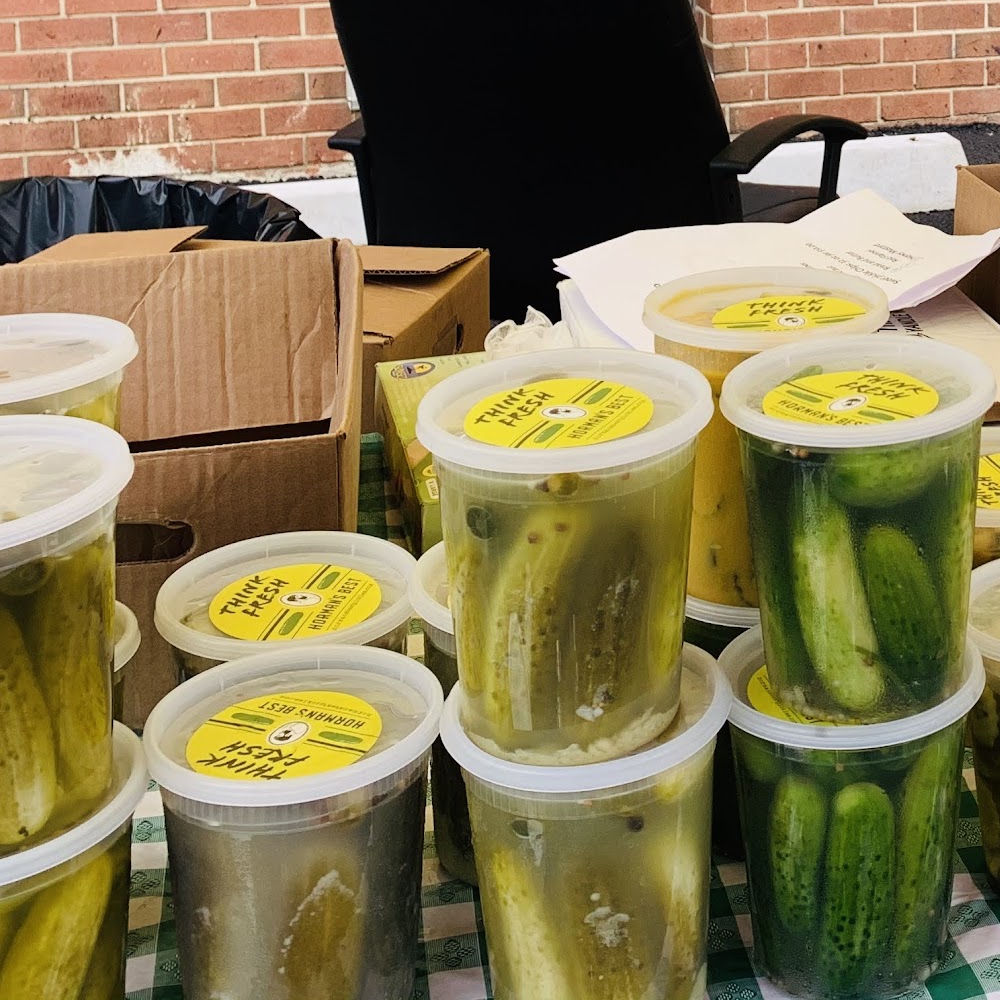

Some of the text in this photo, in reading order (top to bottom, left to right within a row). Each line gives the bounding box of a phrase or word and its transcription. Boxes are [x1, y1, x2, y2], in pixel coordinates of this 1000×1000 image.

[747, 298, 825, 309] THINK
[749, 306, 823, 317] FRESH
[835, 382, 911, 401] FRESH
[857, 374, 931, 395] THINK
[474, 388, 536, 424] THINK
[498, 391, 555, 428] FRESH
[606, 394, 635, 414] BEST
[219, 575, 271, 615] THINK
[337, 578, 362, 596] BEST
[242, 578, 289, 618] FRESH
[258, 701, 295, 715] BEST
[219, 740, 311, 766] FRESH
[197, 753, 287, 780] THINK
